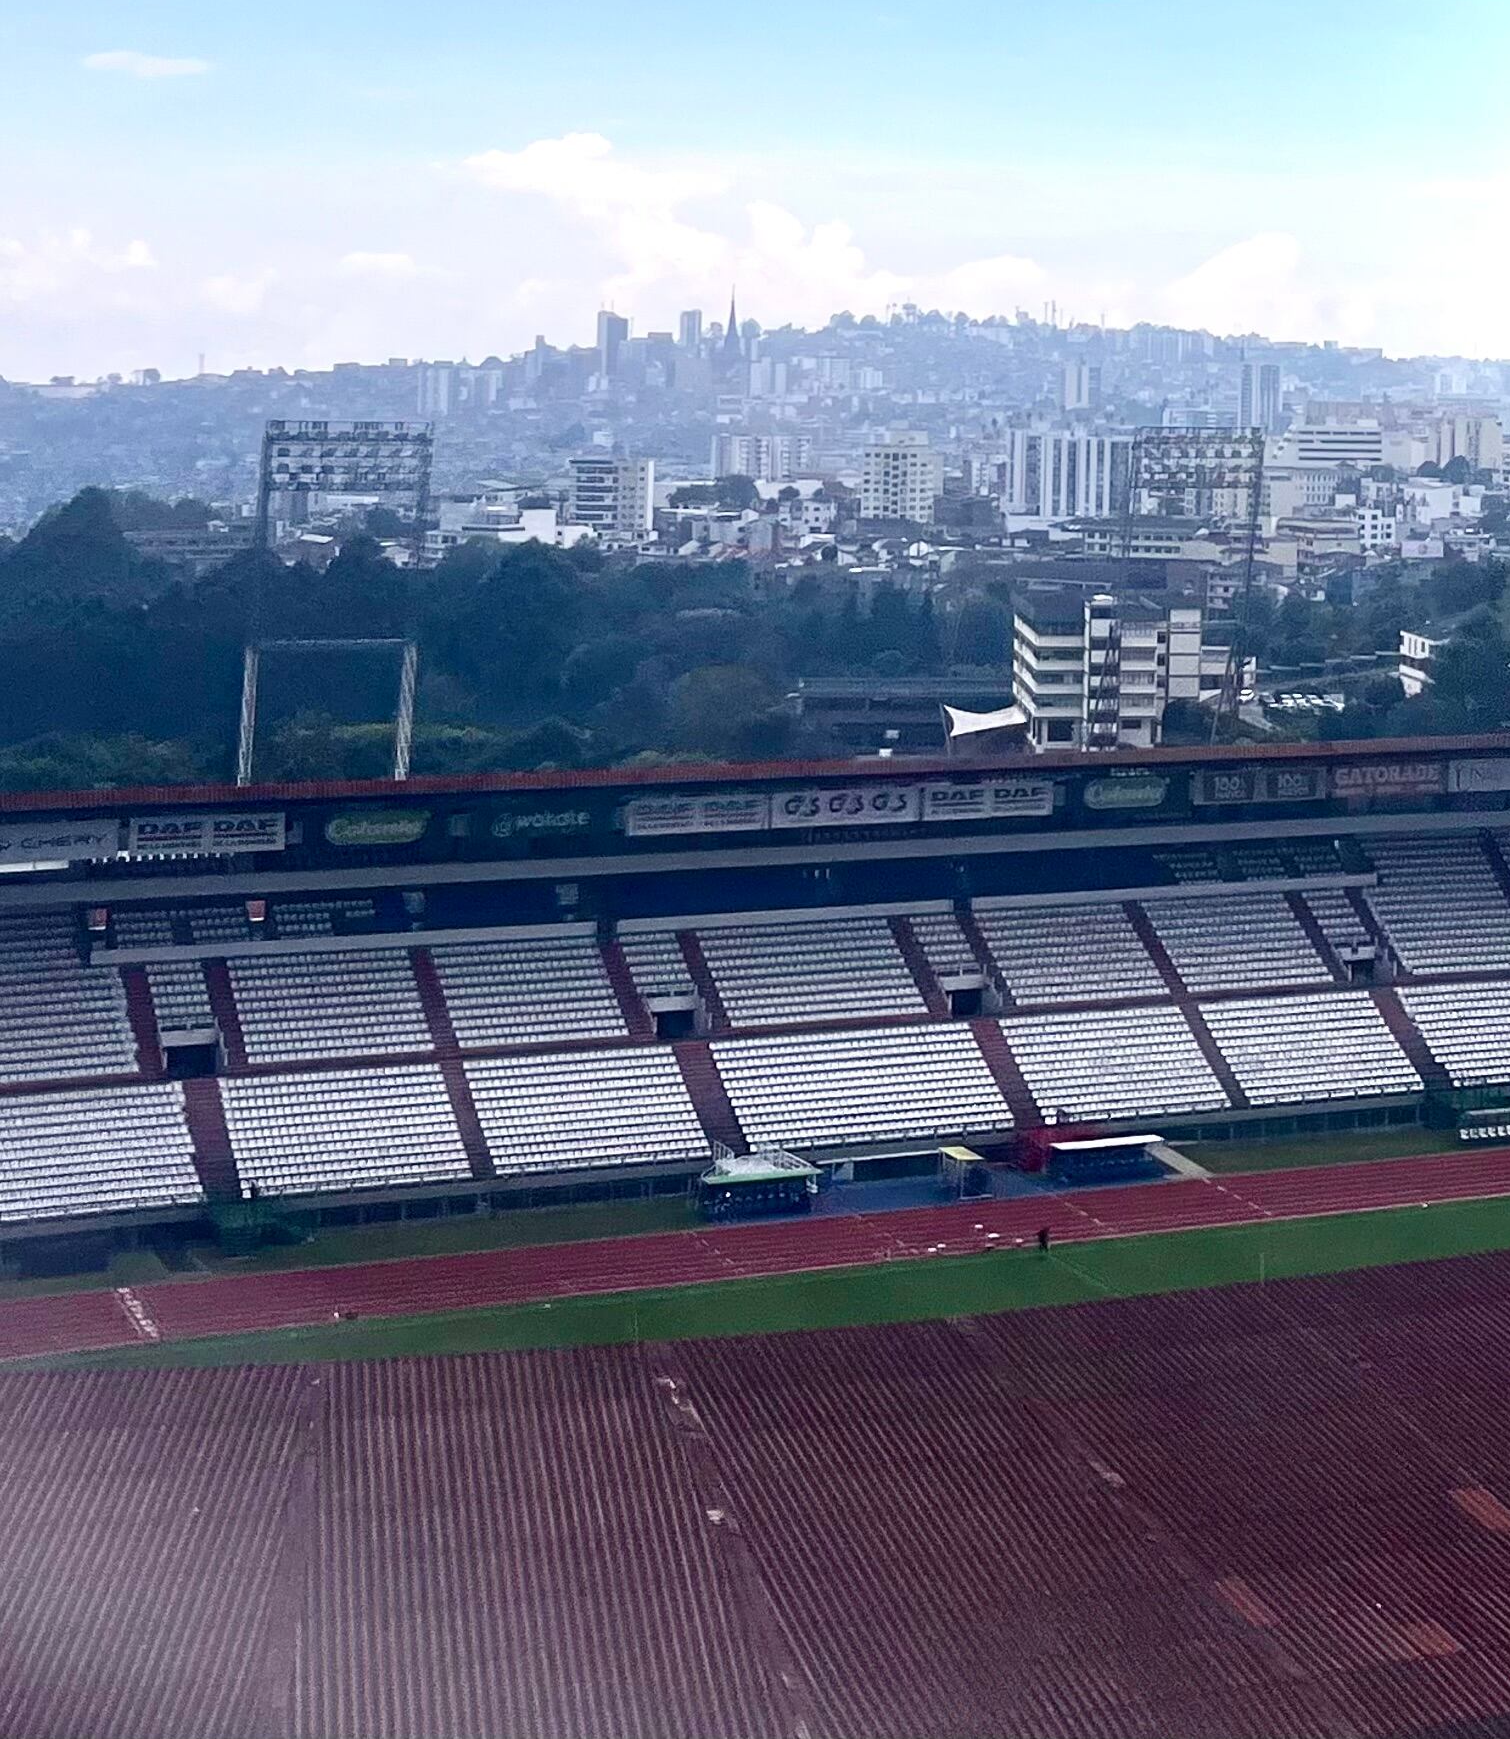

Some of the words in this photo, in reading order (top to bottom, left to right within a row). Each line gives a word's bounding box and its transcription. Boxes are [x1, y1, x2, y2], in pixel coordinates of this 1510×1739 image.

[1334, 764, 1440, 785] GATORADE
[930, 789, 985, 801] DAF
[993, 787, 1048, 799] DAF
[137, 821, 203, 835] DAF
[213, 818, 279, 832] DAF
[20, 833, 109, 851] CHERY
